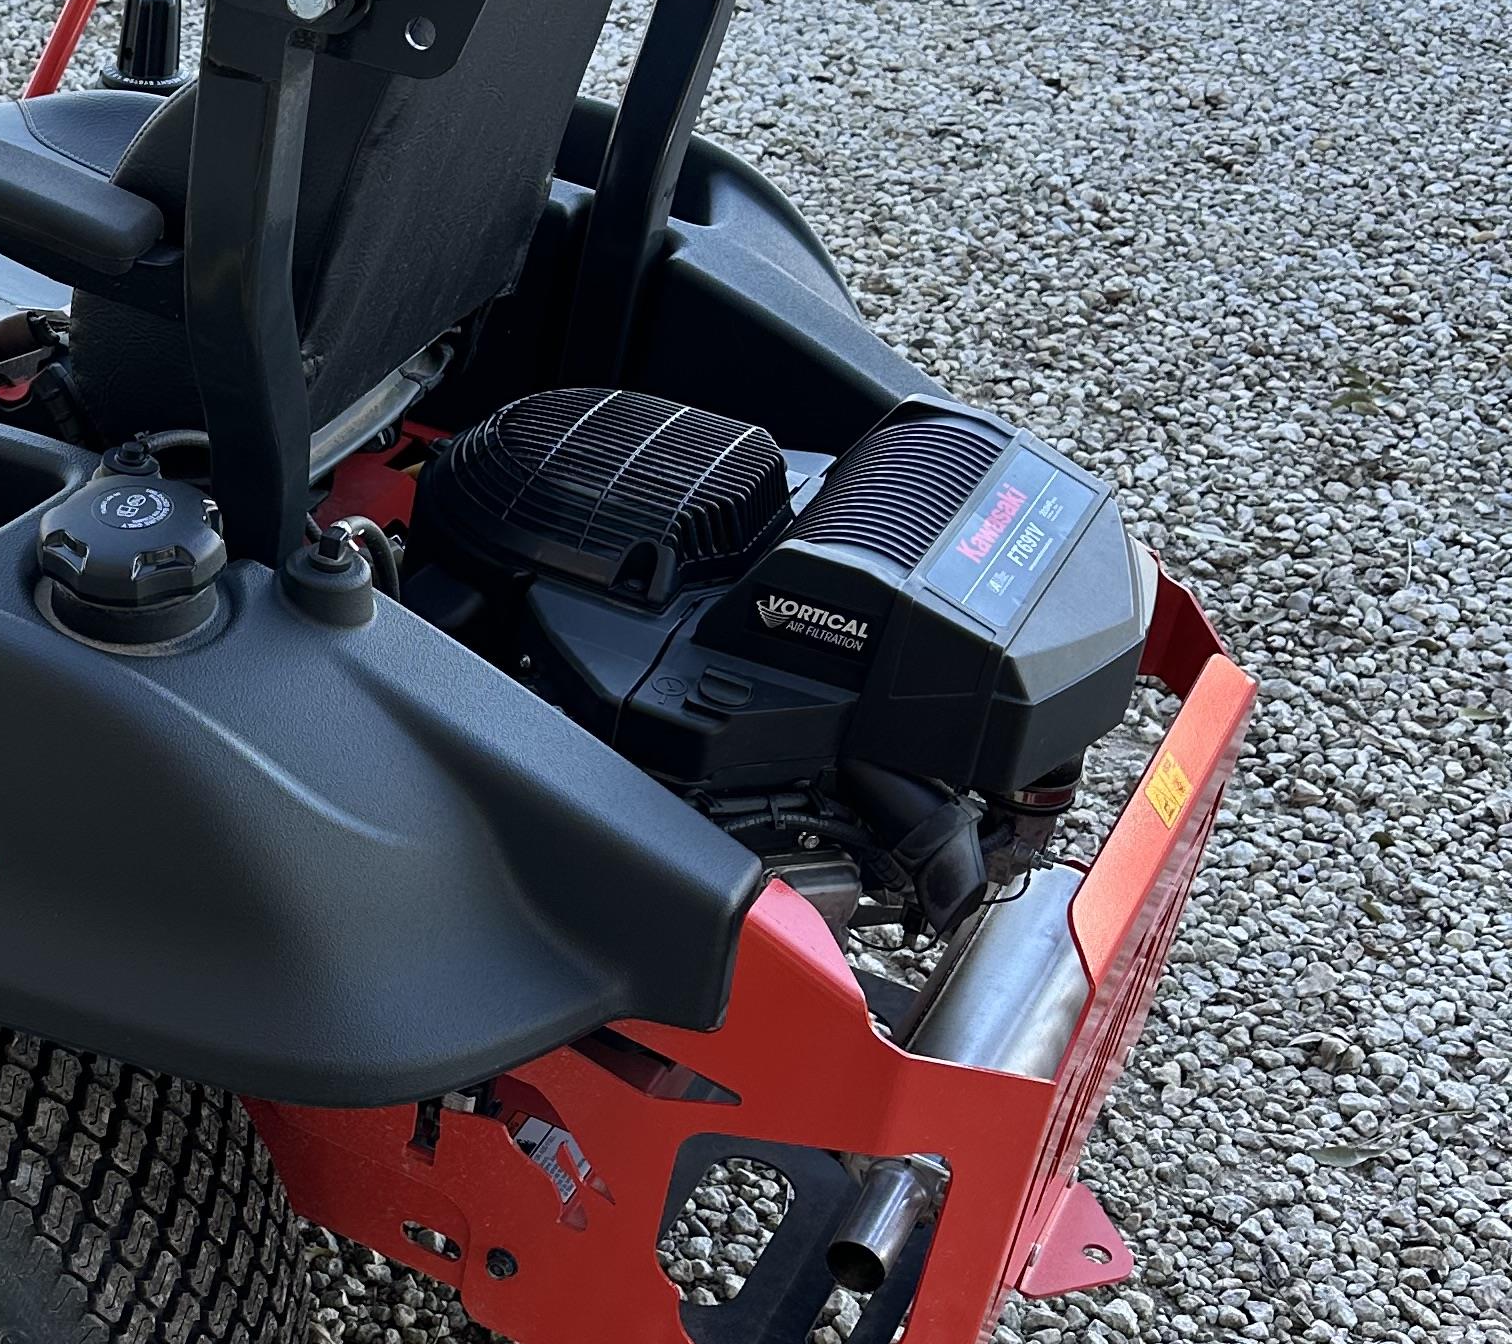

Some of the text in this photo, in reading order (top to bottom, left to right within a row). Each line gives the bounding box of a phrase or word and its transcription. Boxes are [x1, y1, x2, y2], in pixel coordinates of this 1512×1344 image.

[956, 482, 1029, 564] Kawasaki
[1006, 521, 1045, 567] FT691V
[769, 595, 868, 639] VORTICAL
[786, 620, 864, 652] AIR FILTRATION
